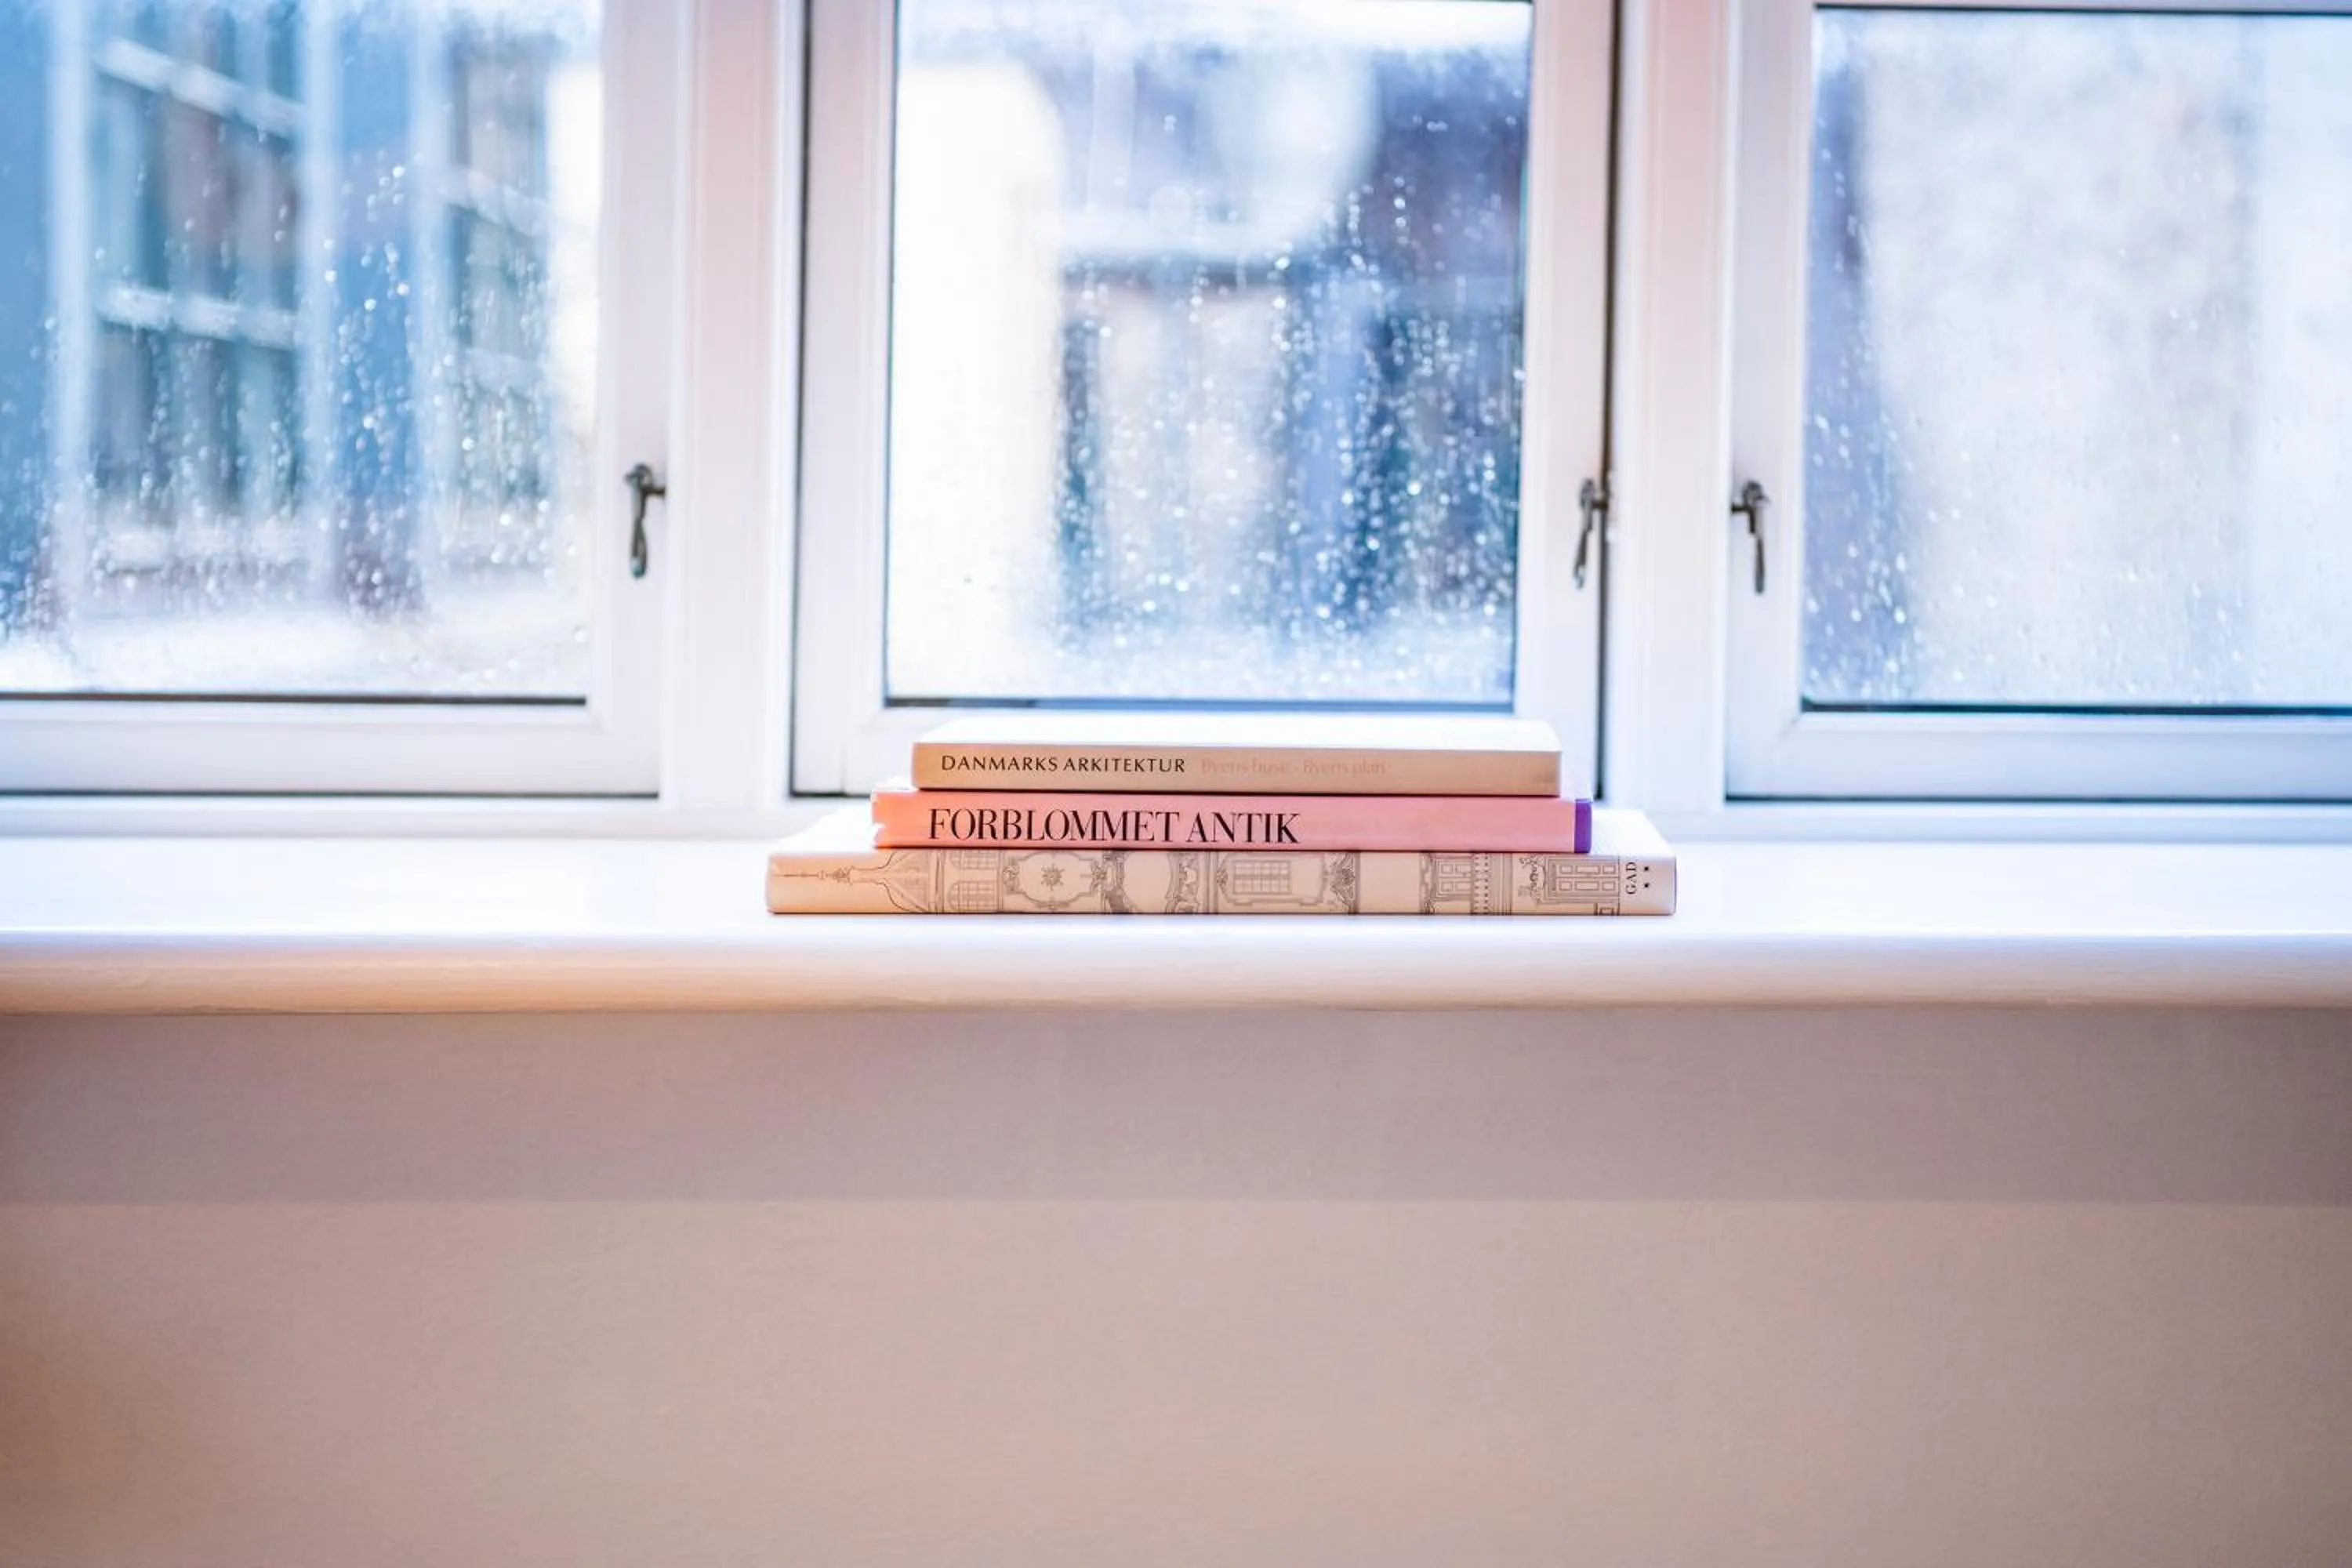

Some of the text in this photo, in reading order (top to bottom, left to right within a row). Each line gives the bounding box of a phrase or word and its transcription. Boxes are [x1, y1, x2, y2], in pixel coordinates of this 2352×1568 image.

[942, 755, 1058, 771] DANMARKS
[1063, 757, 1185, 773] ARKITEKTUR
[928, 808, 1301, 844] FORBLOMMET ANTIK
[1625, 862, 1637, 895] GAD
